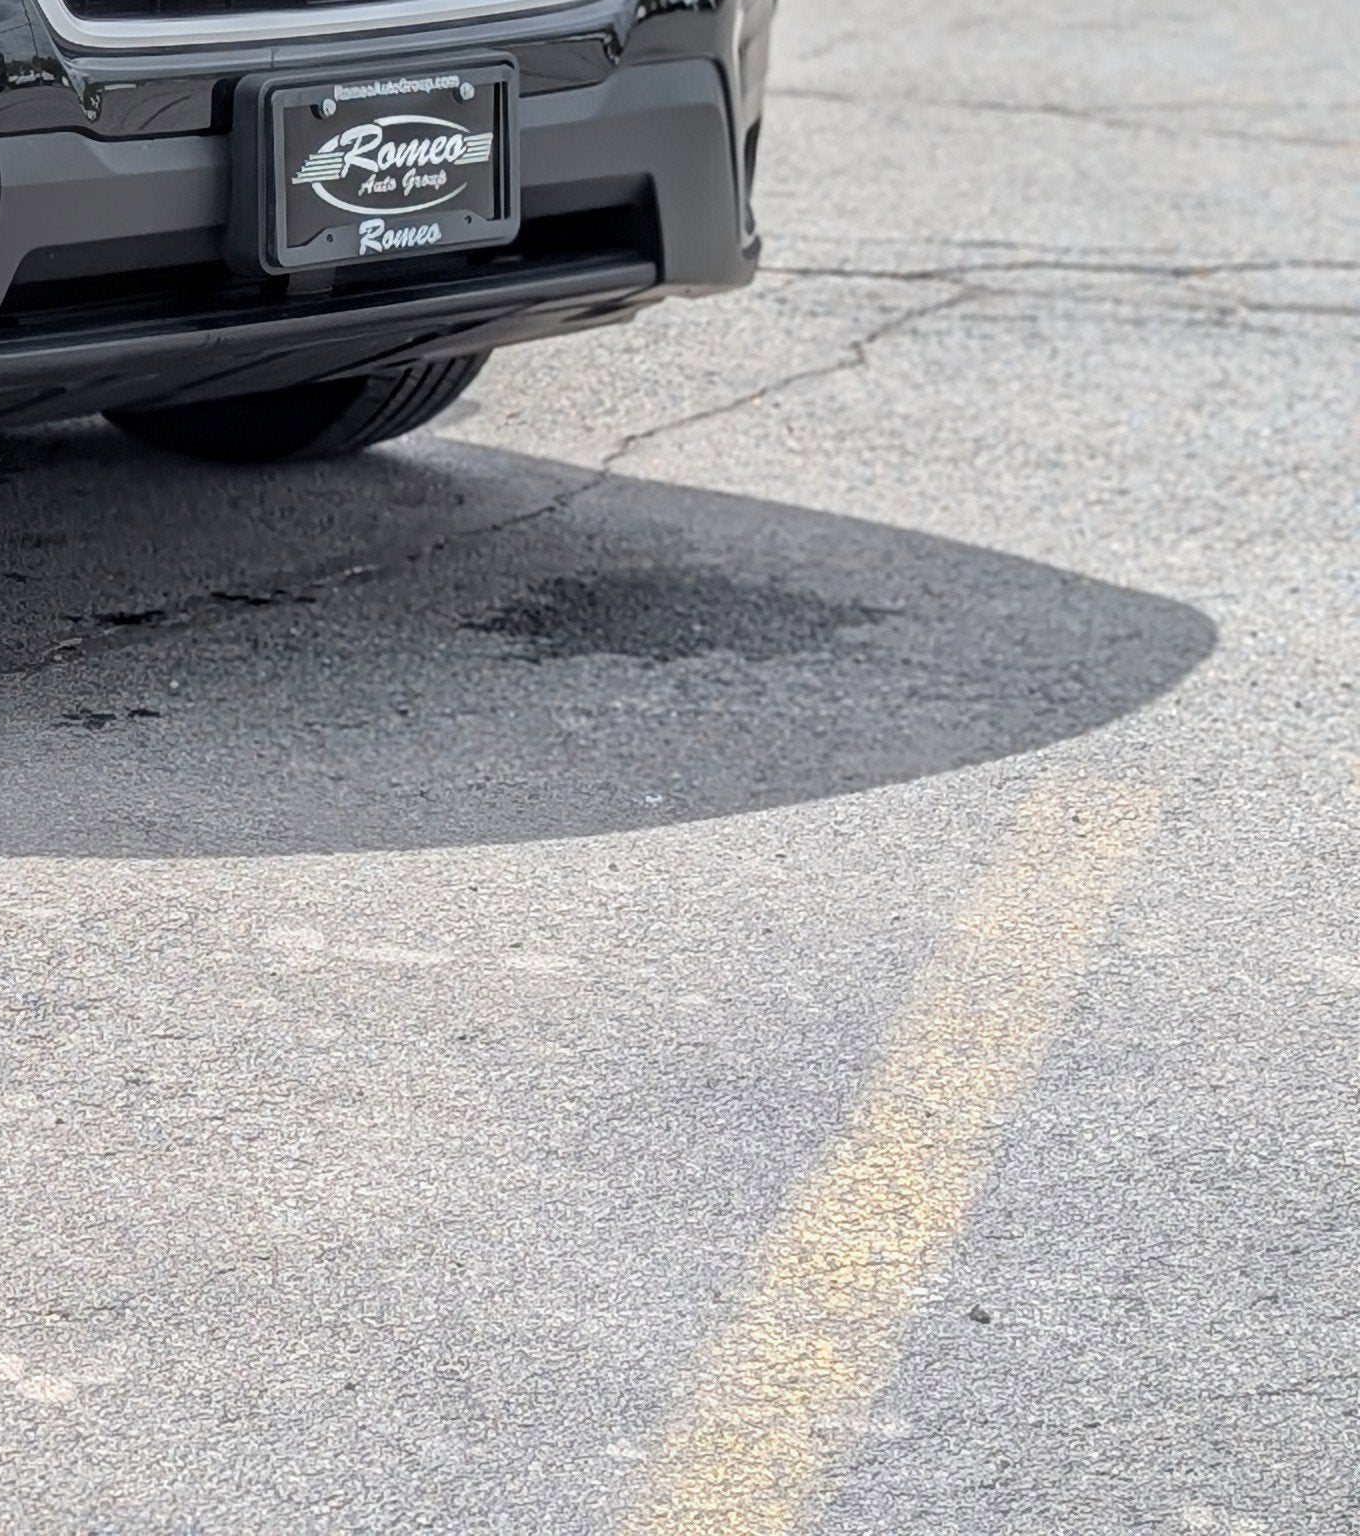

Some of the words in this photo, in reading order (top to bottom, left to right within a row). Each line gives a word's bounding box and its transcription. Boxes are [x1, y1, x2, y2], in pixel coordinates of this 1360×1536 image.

[340, 123, 467, 178] Romeo
[357, 173, 397, 197] Auto
[401, 167, 448, 197] Group
[358, 217, 442, 255] Romeo
